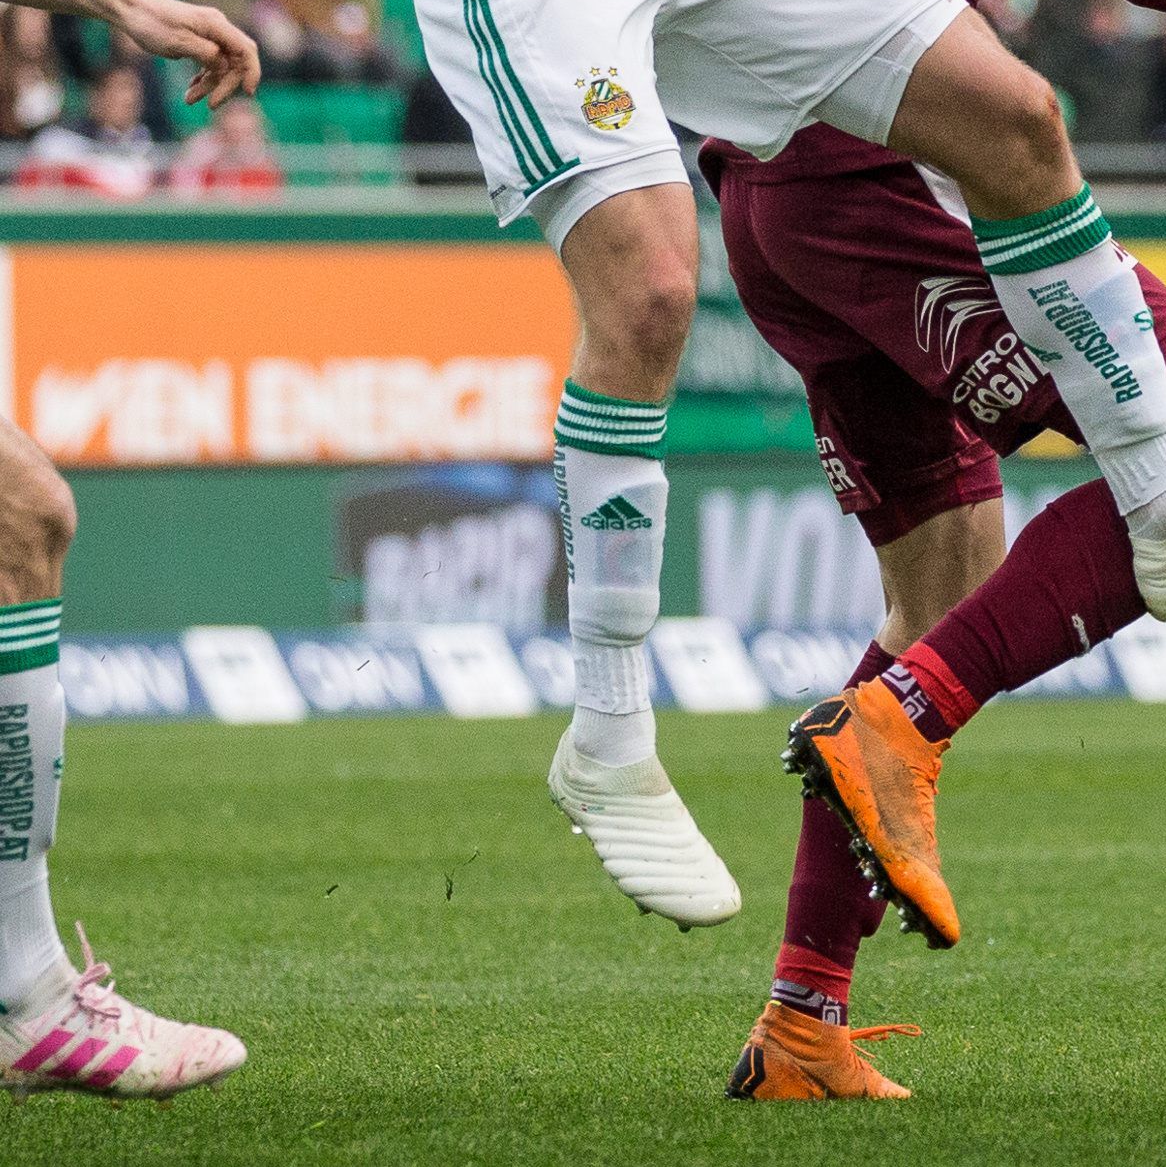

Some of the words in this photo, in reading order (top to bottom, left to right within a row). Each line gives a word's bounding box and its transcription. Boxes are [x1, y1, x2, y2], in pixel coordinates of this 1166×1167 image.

[32, 361, 234, 459] WIEN
[244, 356, 555, 457] ENERGIE
[581, 516, 653, 531] adidas
